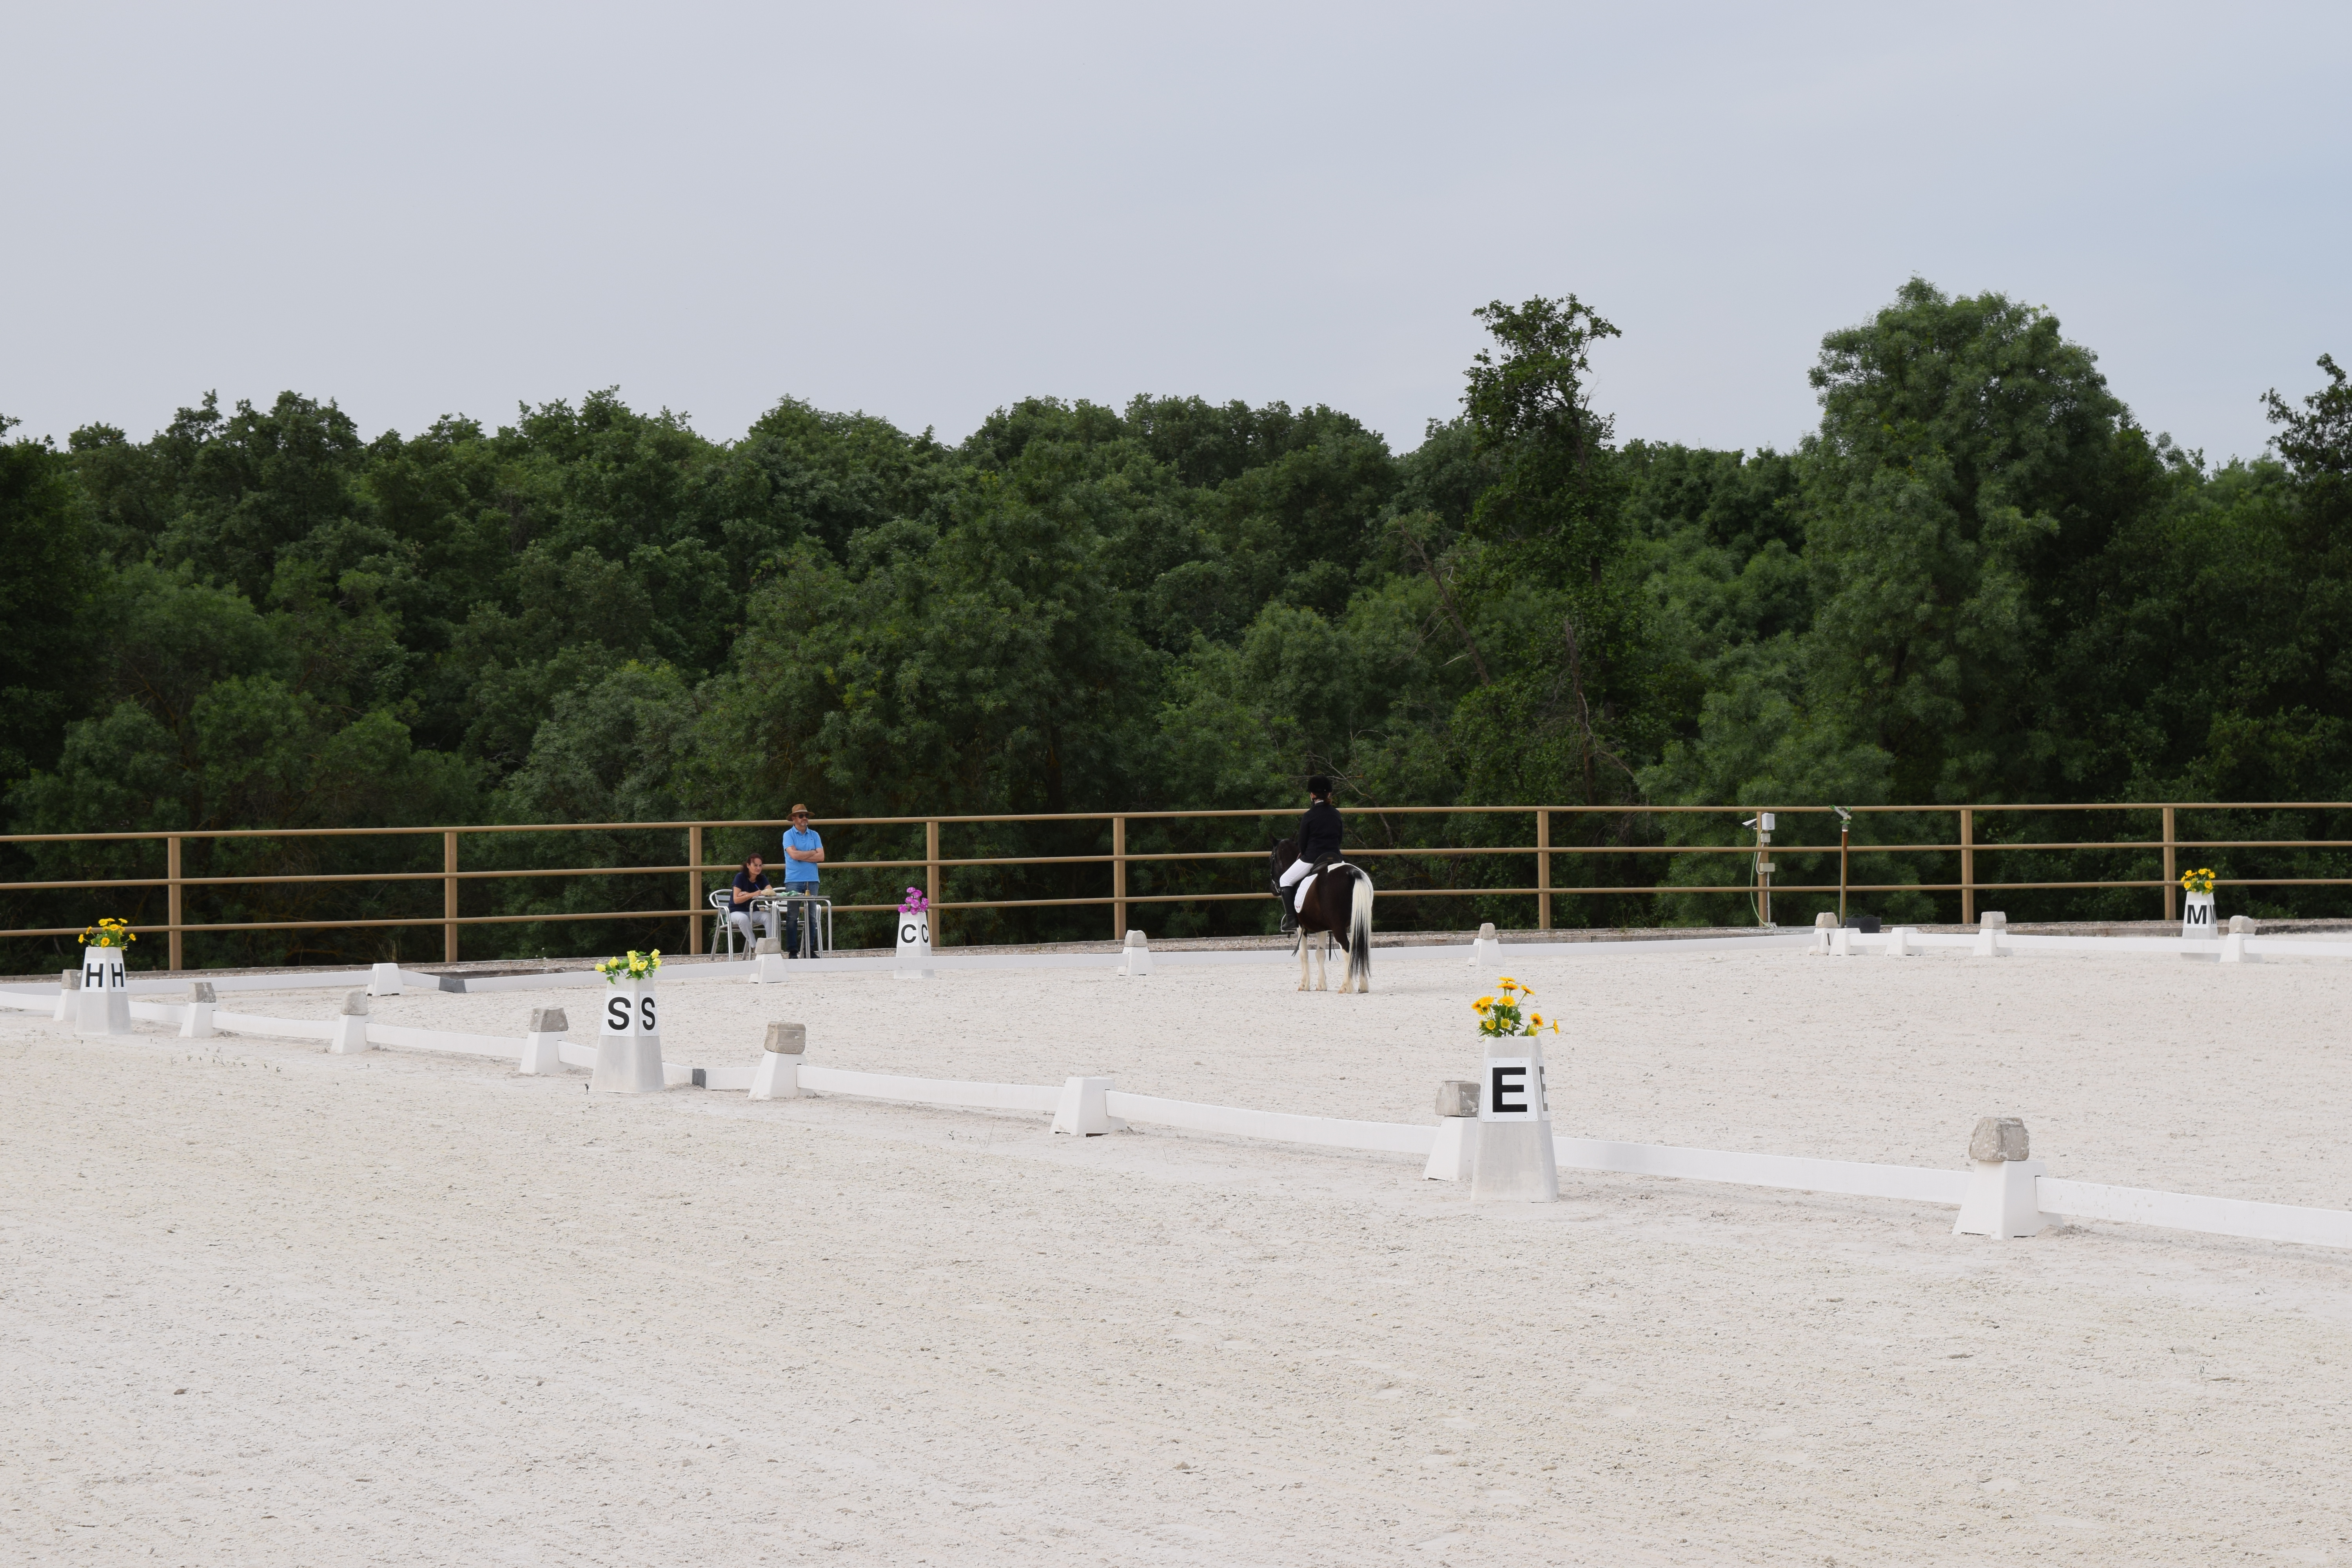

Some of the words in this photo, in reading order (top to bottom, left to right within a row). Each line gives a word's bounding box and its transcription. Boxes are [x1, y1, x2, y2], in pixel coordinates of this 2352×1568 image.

[2187, 905, 2207, 924] M
[901, 924, 916, 943] C
[921, 924, 929, 943] C
[85, 963, 103, 987] H
[111, 963, 124, 987] H
[608, 997, 631, 1030] S
[641, 997, 655, 1031] S
[1492, 1067, 1528, 1112] E
[1539, 1066, 1548, 1111] E
